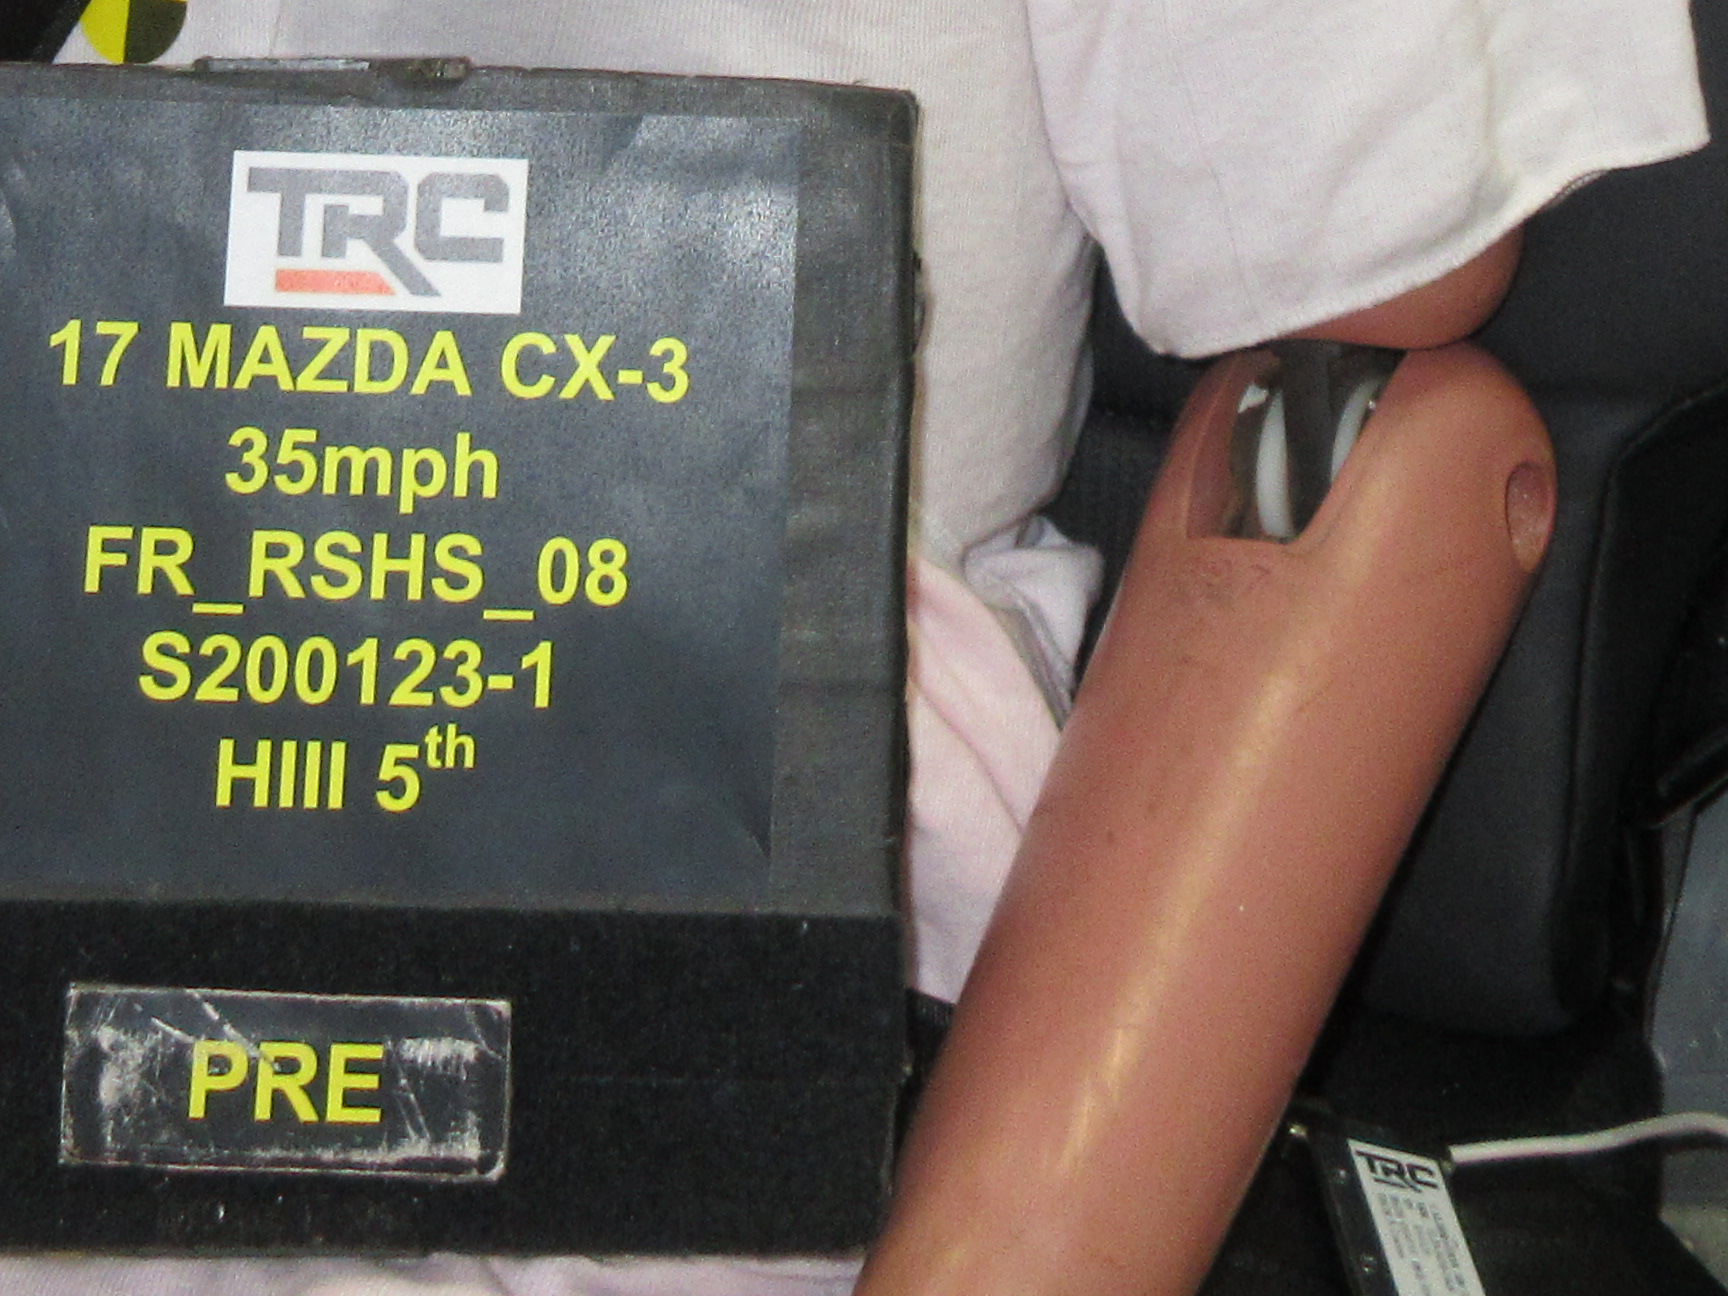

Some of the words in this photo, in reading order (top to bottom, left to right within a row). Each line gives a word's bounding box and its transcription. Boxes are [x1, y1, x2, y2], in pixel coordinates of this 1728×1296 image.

[246, 164, 510, 297] TRC
[47, 318, 139, 387] 17
[166, 321, 474, 395] MAZDA
[499, 330, 691, 403] CX-3
[224, 425, 499, 515] 35mph
[83, 525, 628, 620] FR_RSHS_08
[138, 630, 553, 709] S200123-1
[375, 722, 475, 812] 5th
[188, 1039, 386, 1123] PRE
[1355, 1149, 1439, 1194] TRC
